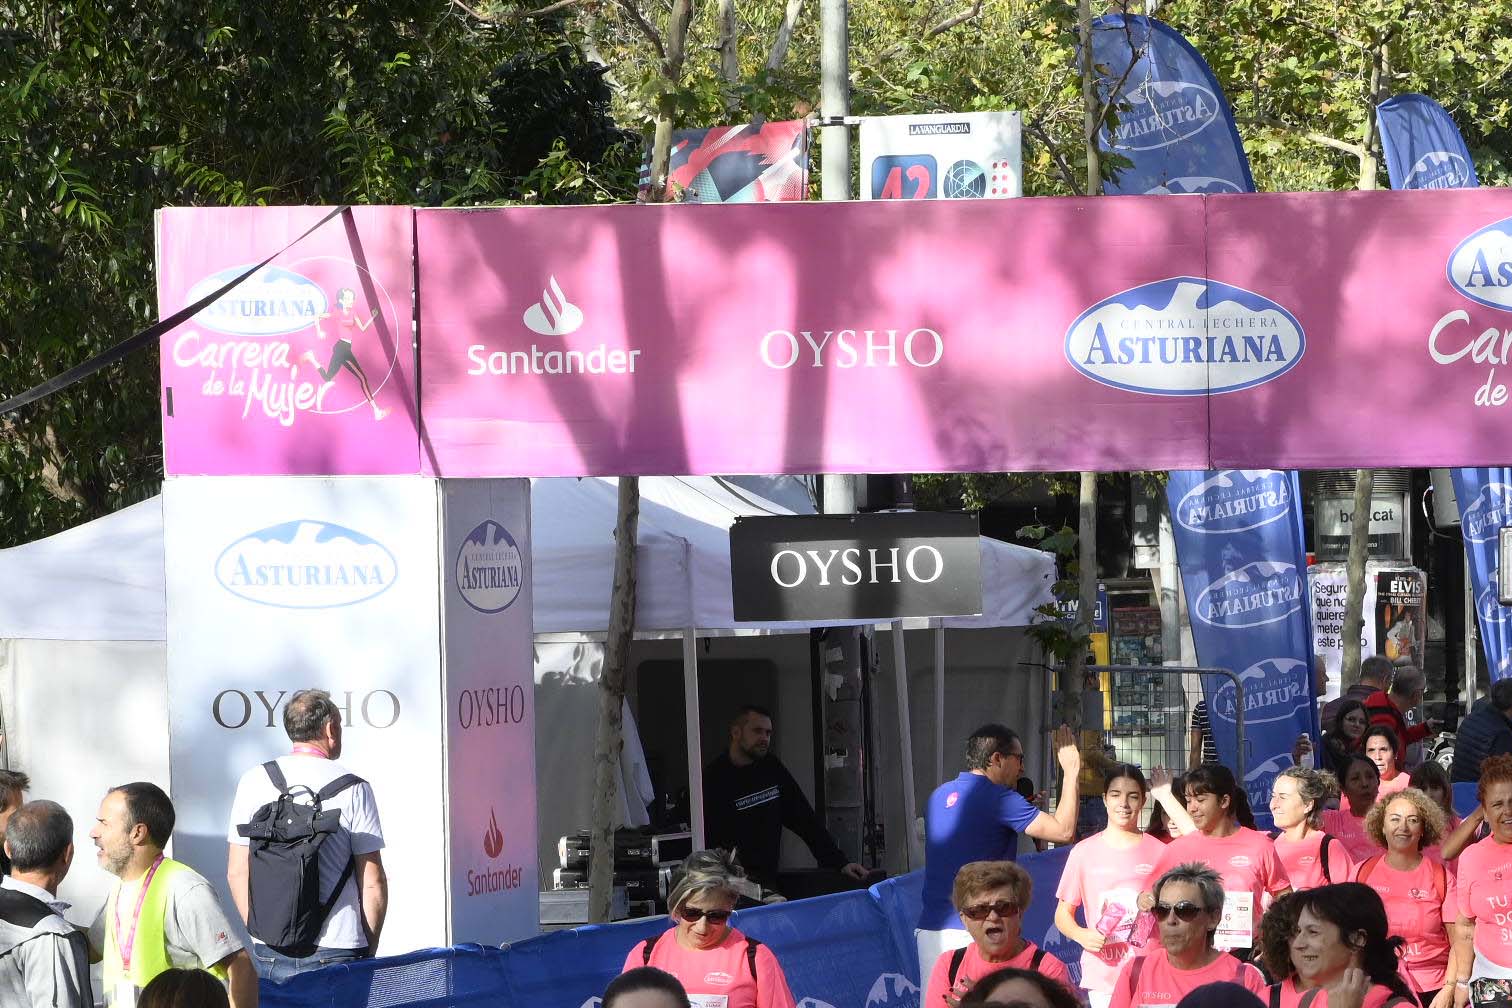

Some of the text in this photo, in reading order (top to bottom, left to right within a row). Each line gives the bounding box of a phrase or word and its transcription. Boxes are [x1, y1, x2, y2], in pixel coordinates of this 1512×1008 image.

[1202, 316, 1279, 329] LECHERA
[173, 329, 290, 368] Carrera
[467, 343, 641, 376] Santander
[760, 328, 944, 369] OYSHO
[1084, 321, 1287, 365] ASTURIANA
[203, 362, 335, 426] de la Mujer
[1474, 367, 1508, 406] de
[230, 553, 386, 587] ASTURIANA
[462, 556, 519, 590] ASTURIANA
[770, 545, 944, 588] OYSHO
[1391, 580, 1421, 593] ELVIS
[1318, 637, 1335, 647] este
[212, 689, 401, 729] OYHO
[458, 685, 525, 730] OYSHO
[467, 864, 523, 897] Santander
[1486, 895, 1508, 910] TU
